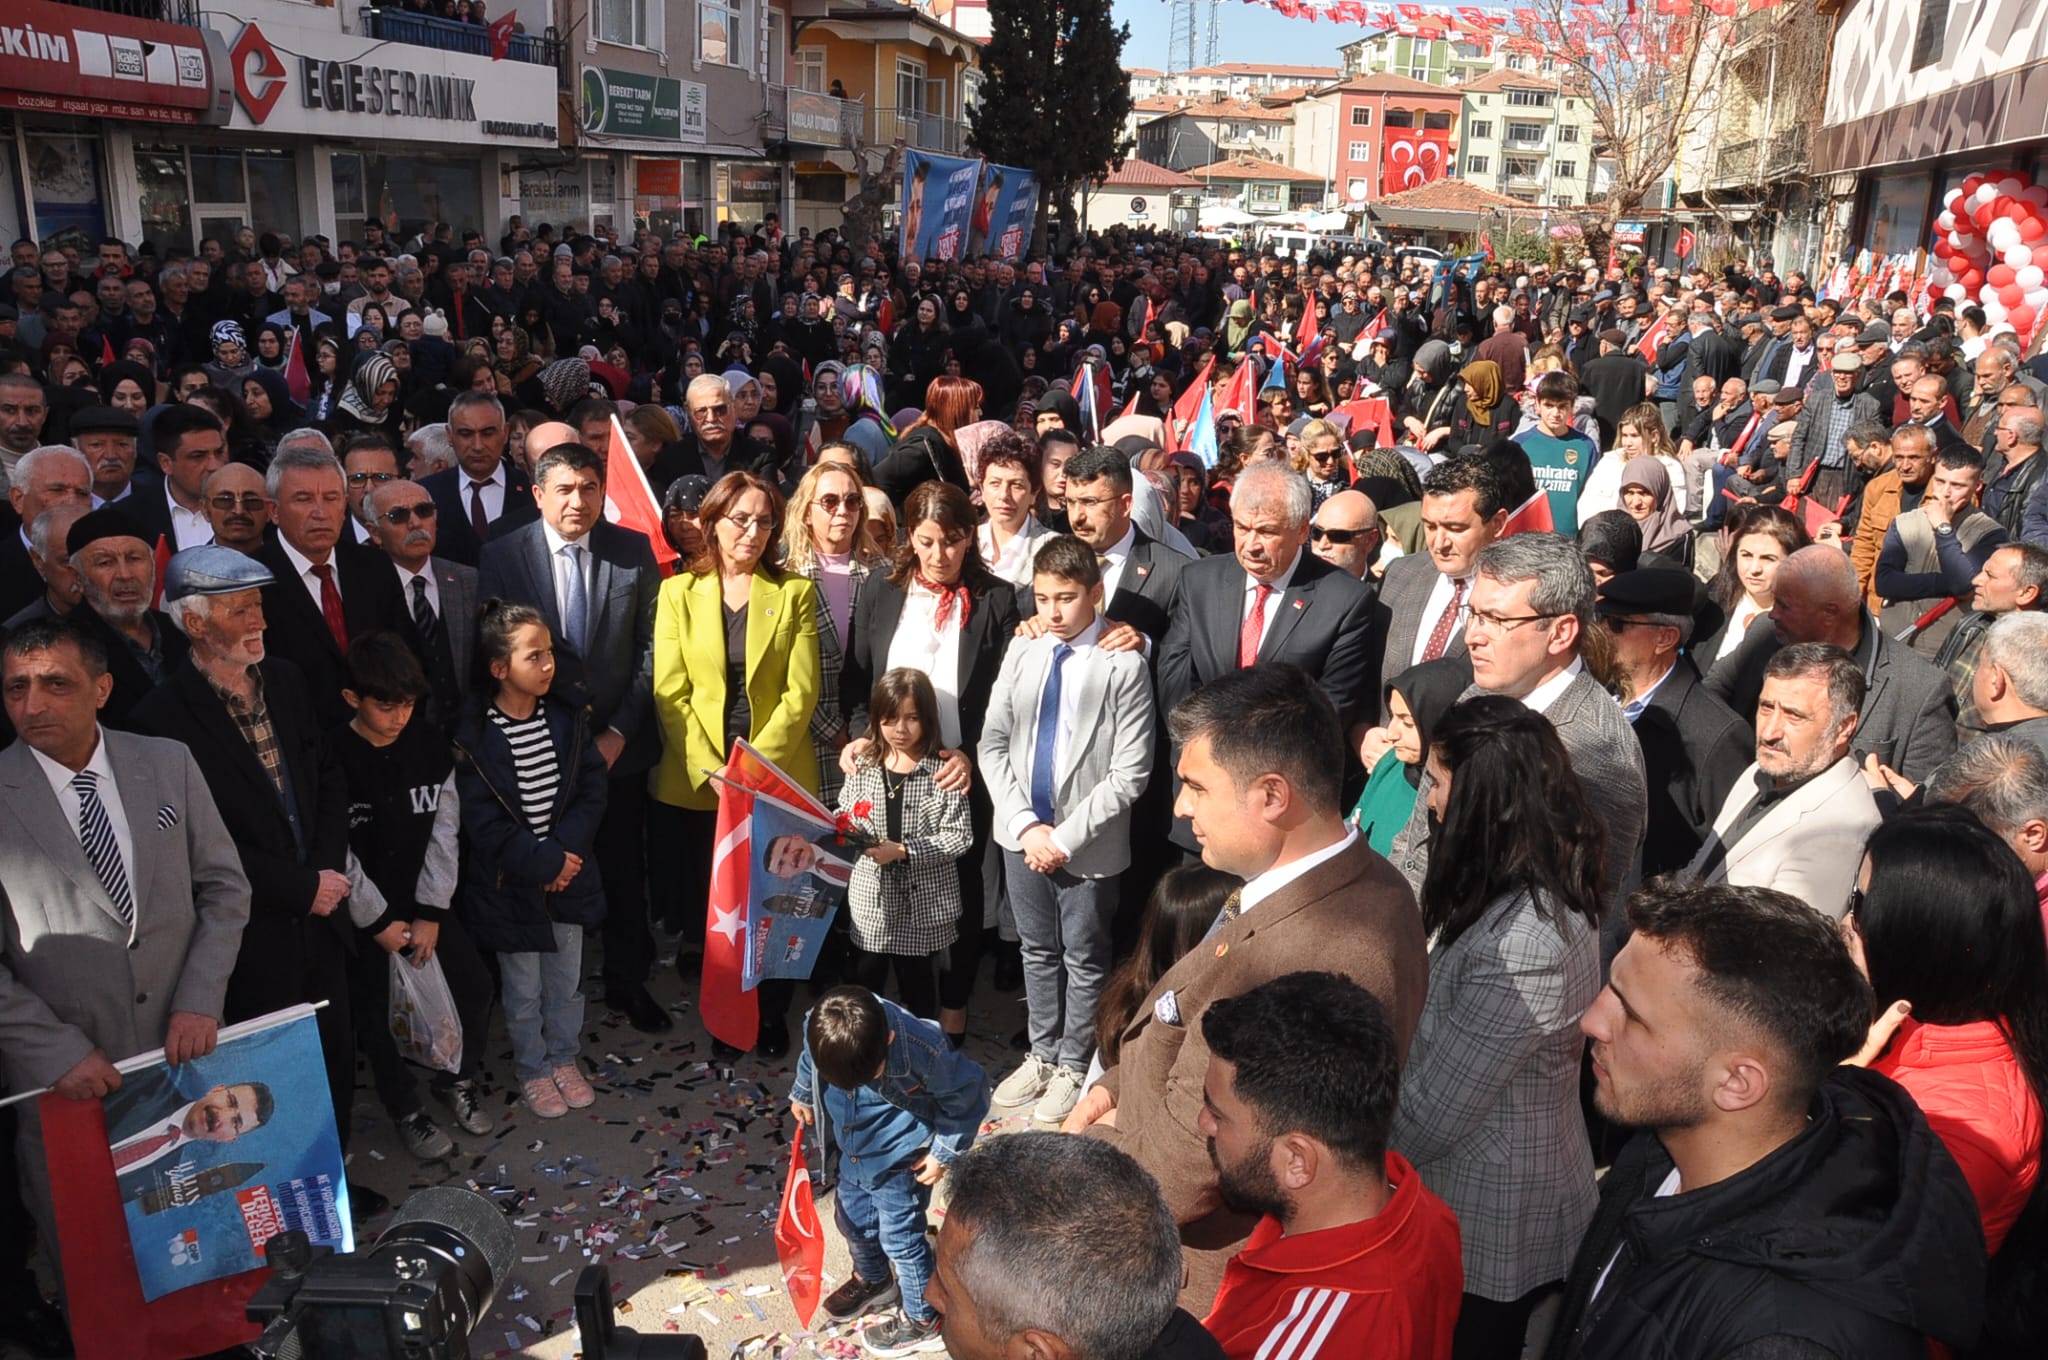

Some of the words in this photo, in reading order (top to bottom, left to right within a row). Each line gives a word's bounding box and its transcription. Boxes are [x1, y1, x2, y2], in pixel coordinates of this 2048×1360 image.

[17, 94, 57, 108] bozoklar
[1531, 464, 1578, 481] mirates
[409, 783, 441, 814] W
